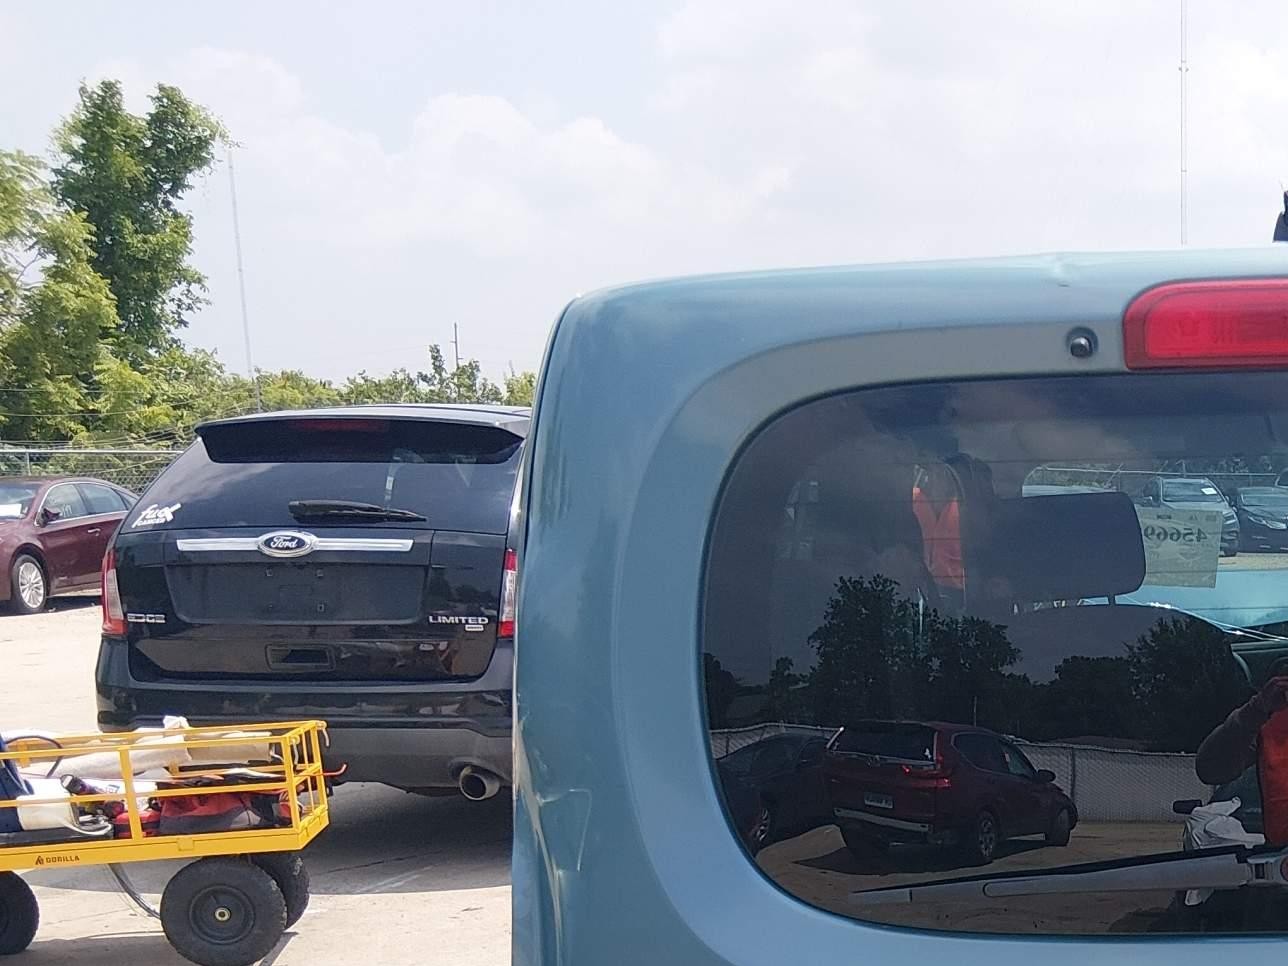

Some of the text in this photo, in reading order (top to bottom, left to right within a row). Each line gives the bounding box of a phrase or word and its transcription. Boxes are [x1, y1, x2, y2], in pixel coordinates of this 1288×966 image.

[270, 536, 299, 549] Ford
[428, 615, 489, 625] LIMITED
[45, 855, 80, 864] GORILLA
